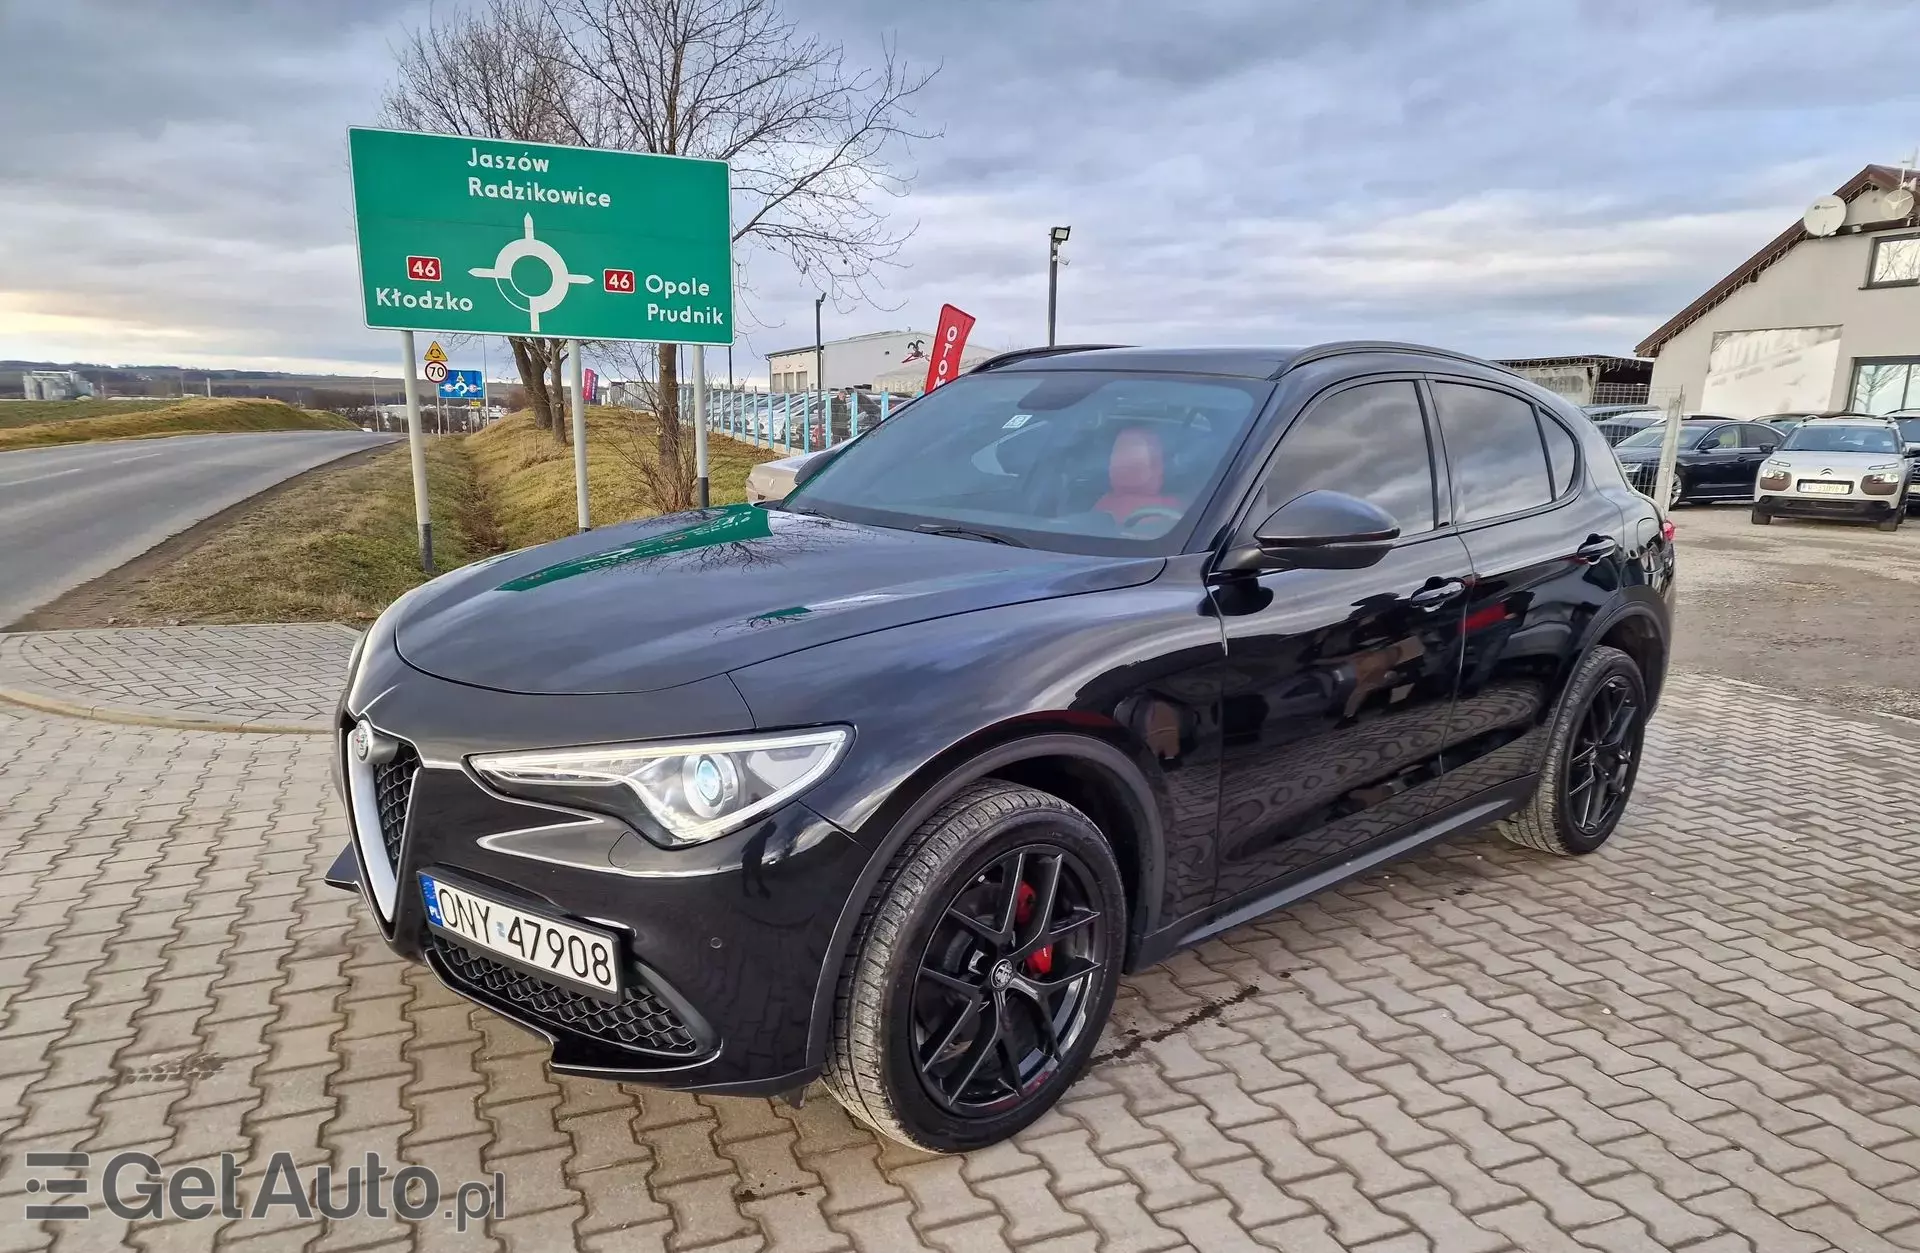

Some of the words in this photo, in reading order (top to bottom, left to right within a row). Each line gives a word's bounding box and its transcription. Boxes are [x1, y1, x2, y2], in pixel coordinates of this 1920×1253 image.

[467, 147, 549, 173] Jaszów
[468, 177, 611, 208] Radzikowice
[412, 261, 437, 277] 46
[608, 274, 630, 289] 46
[645, 274, 710, 299] Opole
[376, 288, 474, 312] Kłodzko
[647, 303, 724, 326] Prudnik
[429, 366, 445, 378] 70
[438, 888, 490, 944] ONY
[507, 915, 611, 986] 47908
